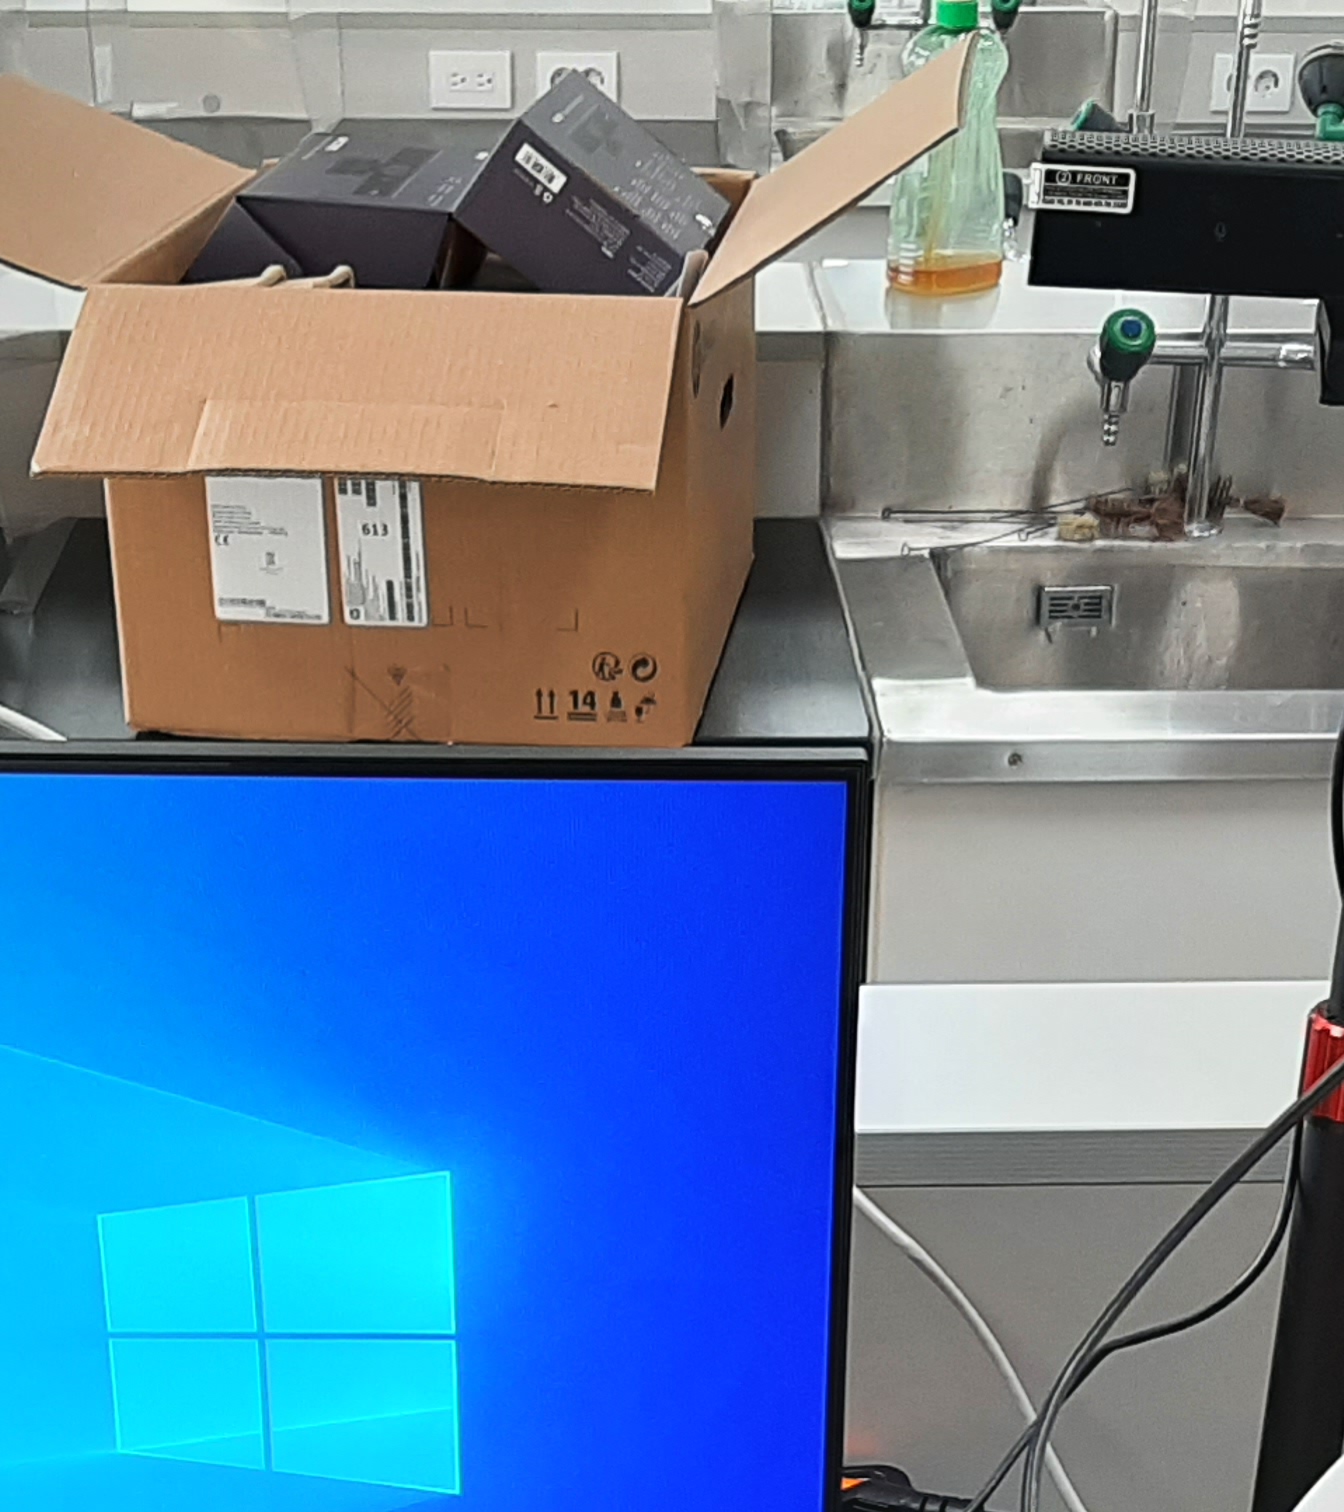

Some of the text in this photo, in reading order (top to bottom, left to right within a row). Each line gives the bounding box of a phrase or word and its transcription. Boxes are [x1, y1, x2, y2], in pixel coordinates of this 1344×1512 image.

[1076, 173, 1119, 185] FRONT
[362, 523, 389, 537] 613
[569, 689, 596, 711] 14
